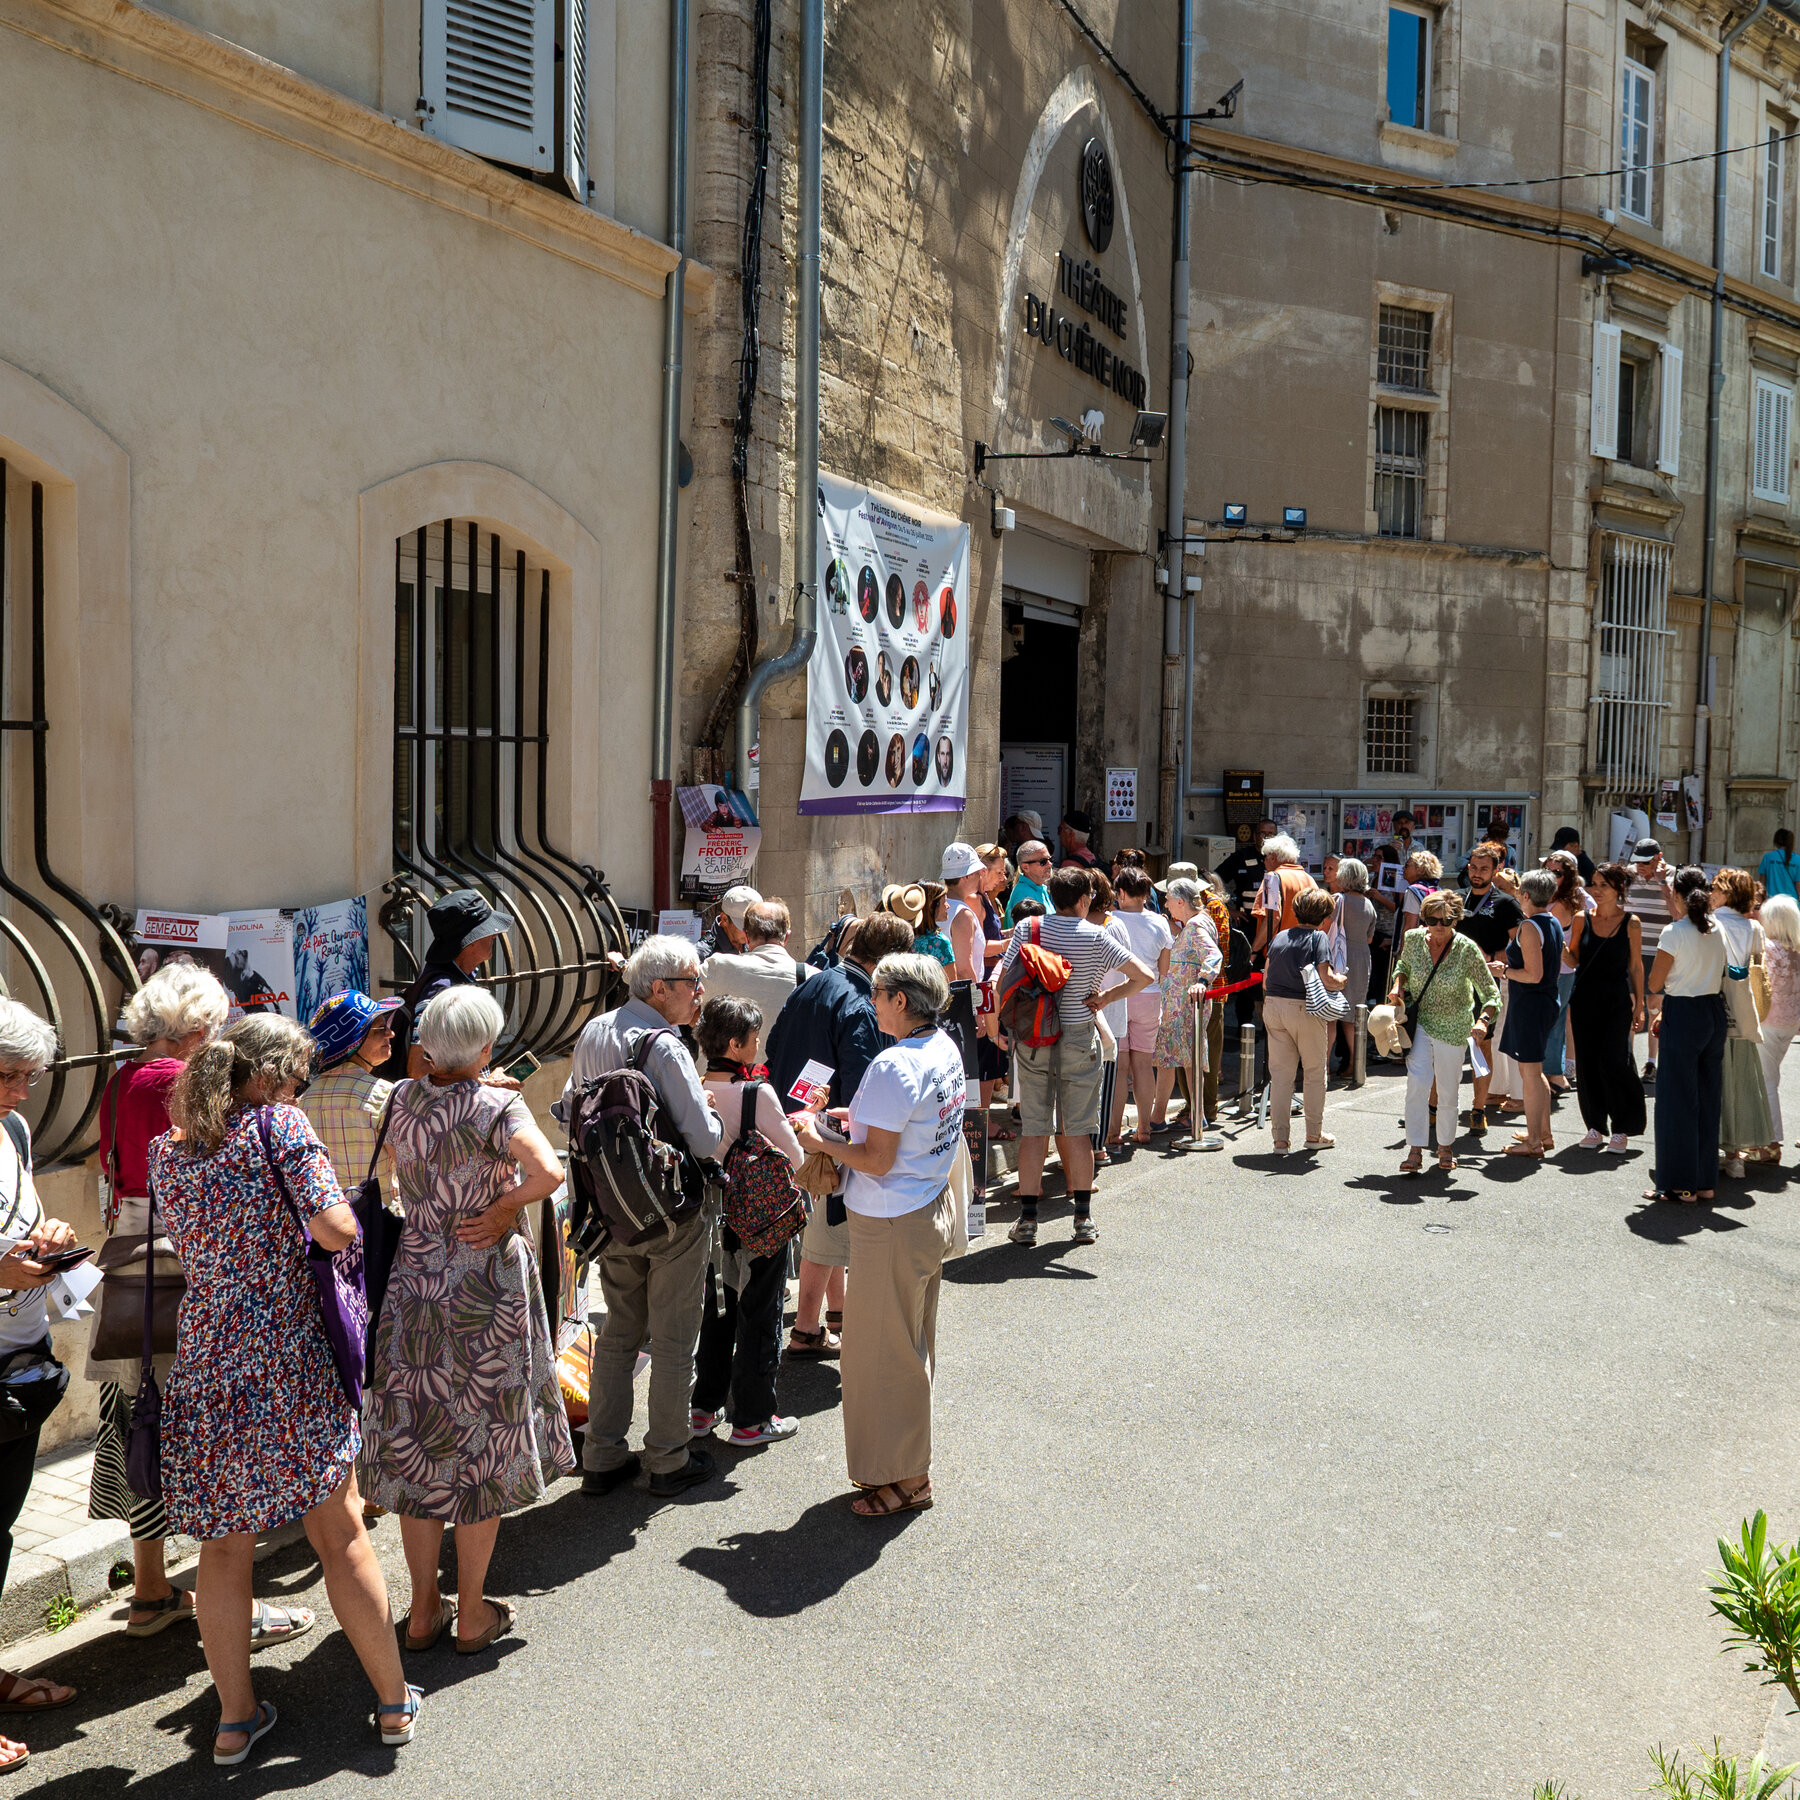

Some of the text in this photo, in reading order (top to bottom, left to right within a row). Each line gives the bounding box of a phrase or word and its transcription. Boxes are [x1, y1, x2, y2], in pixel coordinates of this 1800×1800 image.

[1059, 251, 1127, 340] THÉÂTRE
[1026, 293, 1147, 411] DU CHÊNE NOIR
[890, 510, 897, 519] DU
[912, 519, 922, 528] NOIR
[698, 846, 749, 856] FROMET
[704, 856, 743, 865] SE TIENT
[693, 862, 746, 874] À CARREAU
[145, 922, 198, 936] GEMEAUX
[236, 923, 264, 931] MOLINA
[302, 936, 311, 950] Le
[313, 933, 329, 953] Petit
[322, 944, 344, 964] Rouge
[952, 1070, 964, 1093] INS
[964, 1130, 982, 1138] rets
[970, 1139, 979, 1148] la
[971, 1153, 980, 1161] se
